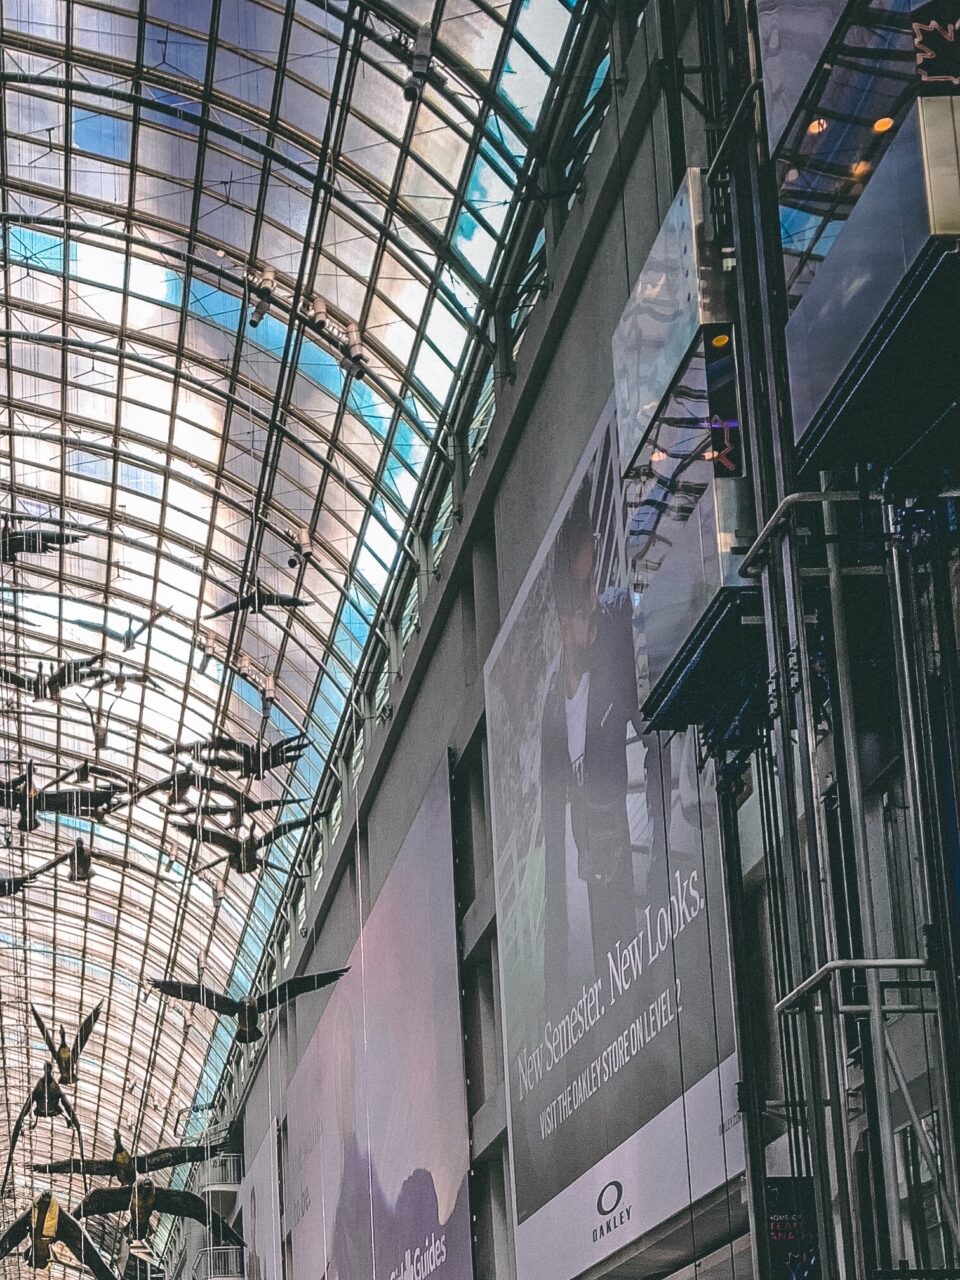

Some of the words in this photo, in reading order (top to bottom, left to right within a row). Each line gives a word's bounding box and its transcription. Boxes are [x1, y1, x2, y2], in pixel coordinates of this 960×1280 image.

[517, 1045, 543, 1101] New
[544, 978, 606, 1071] Semester.
[607, 931, 644, 1006] New
[644, 869, 705, 966] Looks.
[539, 1101, 557, 1140] VISIT
[557, 1086, 573, 1123] THE
[573, 1058, 602, 1108] OAKLEY
[602, 1028, 629, 1083] STORE
[630, 1015, 644, 1056] ON
[644, 988, 675, 1044] LEVEL
[592, 1205, 632, 1243] OAKLEY
